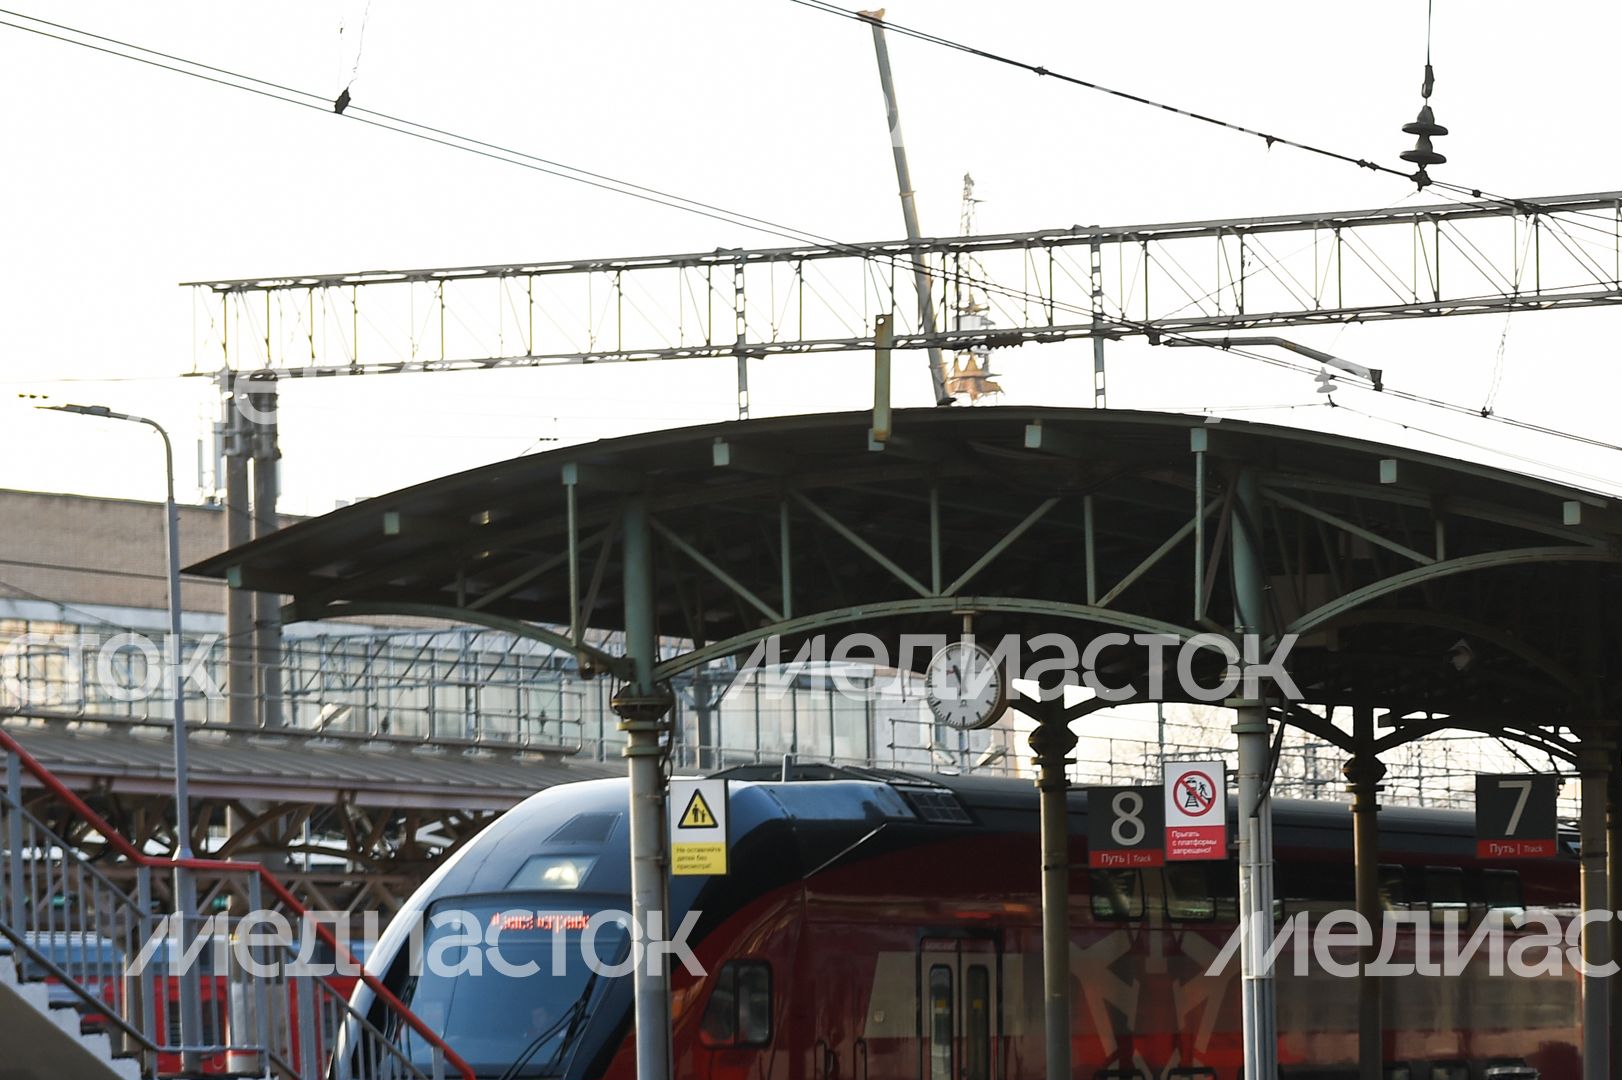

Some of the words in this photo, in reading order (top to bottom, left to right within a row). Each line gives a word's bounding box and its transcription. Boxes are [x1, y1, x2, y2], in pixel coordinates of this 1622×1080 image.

[1111, 791, 1145, 846] 8
[1498, 780, 1532, 836] 7
[1101, 853, 1125, 865] Путь
[1489, 843, 1515, 856] Путь
